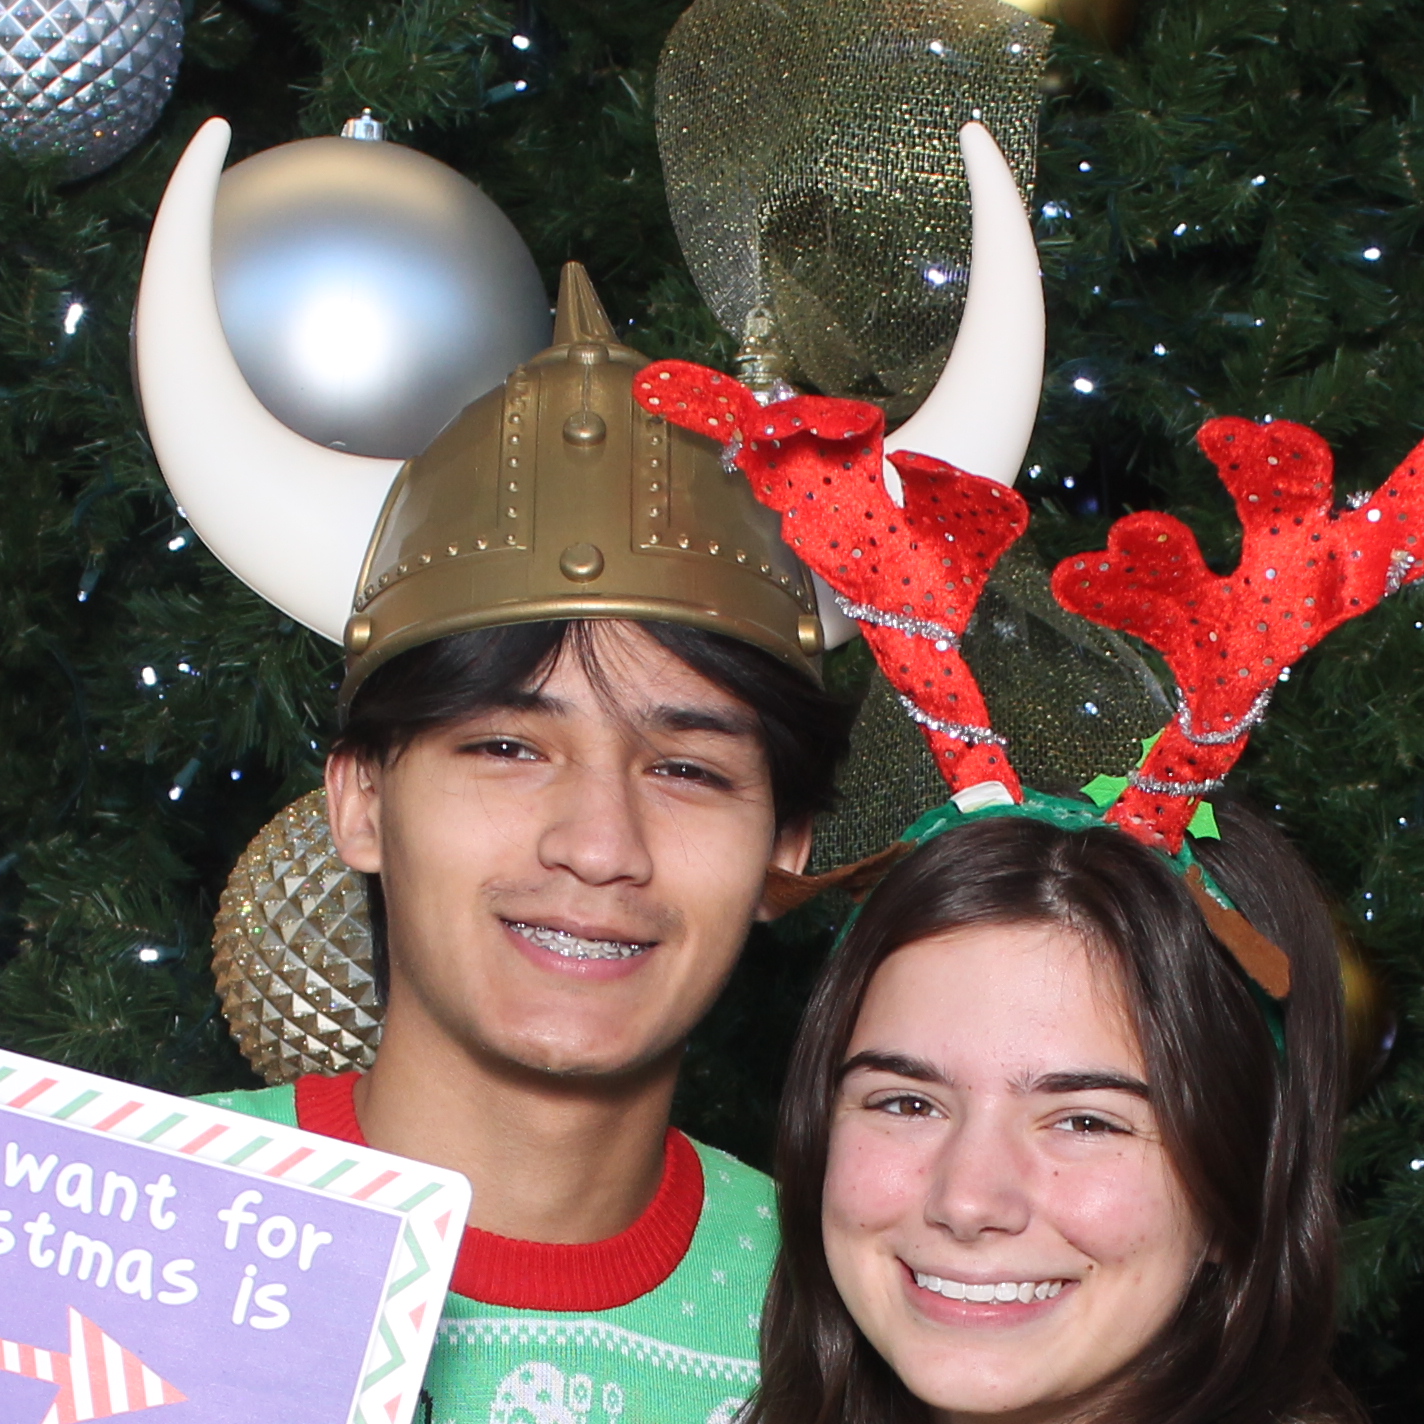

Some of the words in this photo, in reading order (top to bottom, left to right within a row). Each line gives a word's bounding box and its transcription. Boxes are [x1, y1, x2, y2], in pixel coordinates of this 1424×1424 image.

[3, 1140, 181, 1232] want
[216, 1188, 335, 1273] for
[230, 1262, 292, 1332] is
